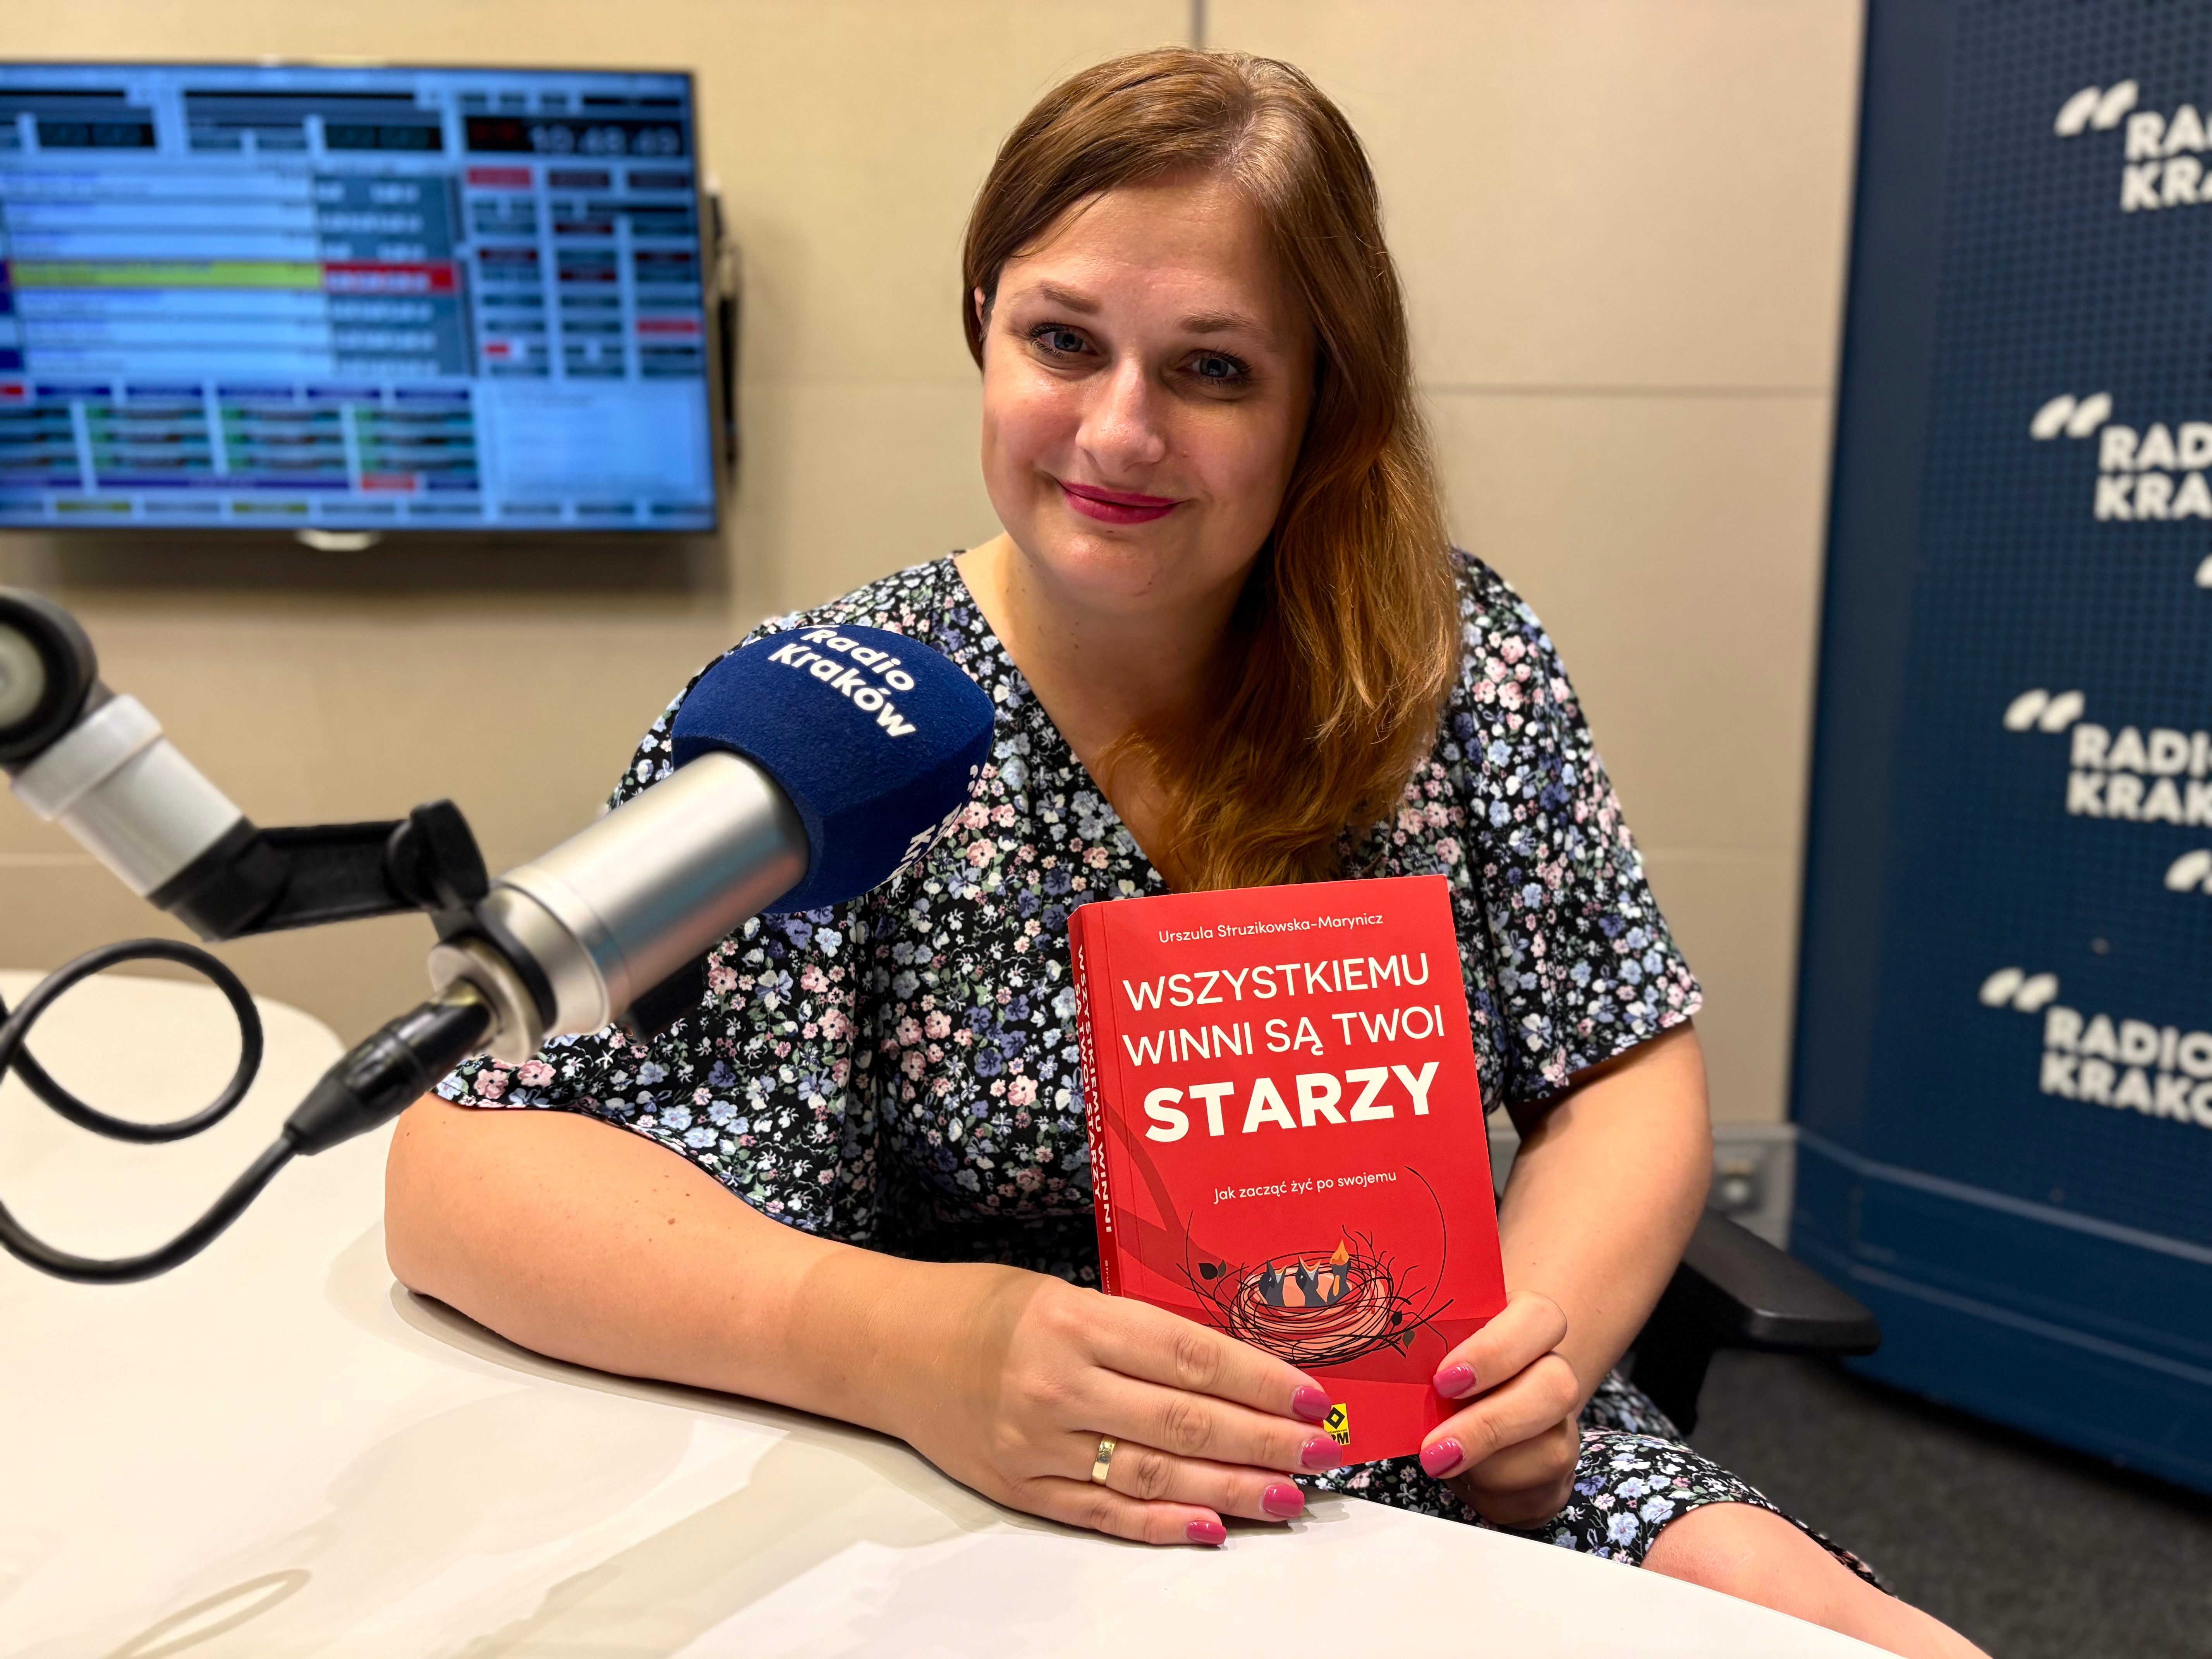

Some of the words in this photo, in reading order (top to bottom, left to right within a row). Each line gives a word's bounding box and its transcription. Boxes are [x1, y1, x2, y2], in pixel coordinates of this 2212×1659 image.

[2124, 104, 2212, 162] RA
[2120, 156, 2212, 212] KR
[768, 643, 916, 737] Kraków
[800, 629, 914, 690] Radio
[2071, 723, 2212, 778] RADI
[1159, 926, 1213, 943] Urszula
[1217, 913, 1384, 938] Struzikowska-Marynicz
[1122, 953, 1429, 1011] WSZYSTKIEMU
[1122, 1022, 1253, 1066] WINNI
[1265, 1017, 1324, 1056] SĄ
[1332, 1005, 1444, 1046] TWOI
[2044, 1006, 2212, 1079] RADIO
[1078, 1021, 1090, 1092] TWOI
[1086, 1103, 1101, 1200] STARZY
[1079, 945, 1101, 1132] WSZYSTKIEMU
[1098, 1142, 1112, 1232] WINNI
[1144, 1061, 1440, 1142] STARZY
[1214, 1186, 1236, 1204] Jak
[1239, 1181, 1287, 1197] zacząć
[1291, 1178, 1313, 1195] żyć
[1317, 1179, 1334, 1192] po
[1338, 1172, 1397, 1188] swojemu
